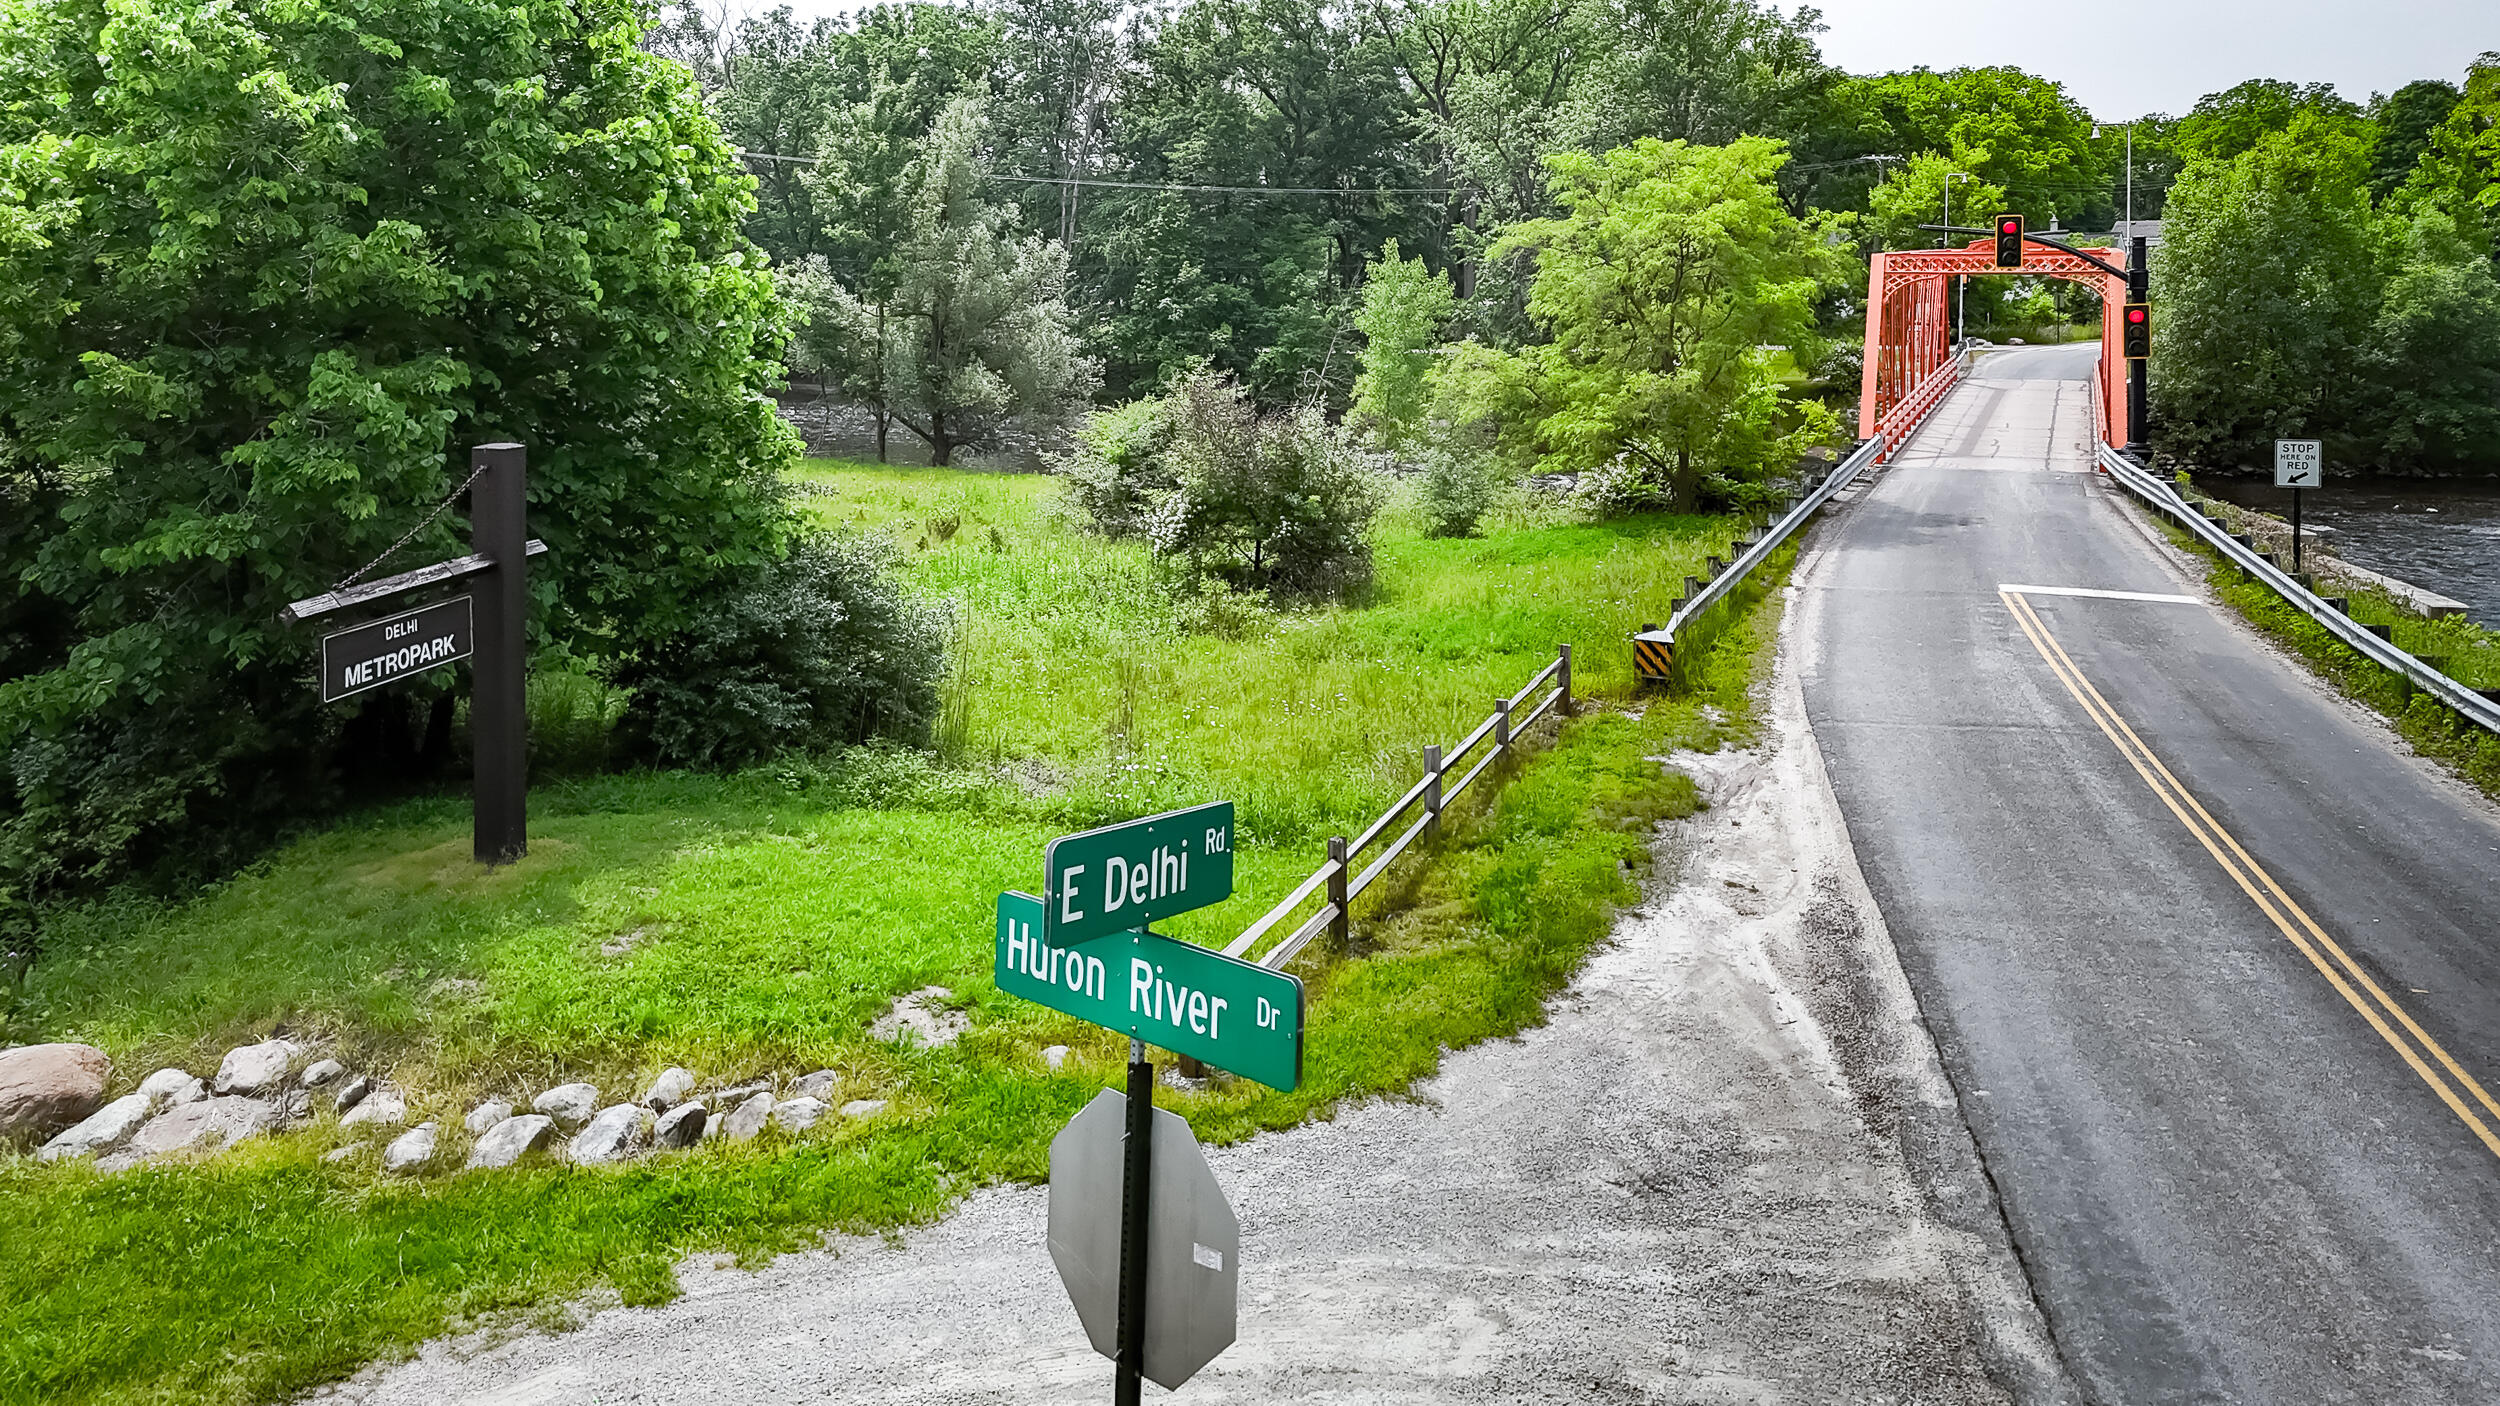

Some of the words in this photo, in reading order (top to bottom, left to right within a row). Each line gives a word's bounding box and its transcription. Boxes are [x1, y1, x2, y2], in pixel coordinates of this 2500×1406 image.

[2282, 443, 2314, 453] STOP
[2287, 462, 2309, 470] RED
[385, 618, 418, 641] DELHI
[344, 634, 456, 689] METROPARK
[1061, 864, 1085, 924] E
[1104, 839, 1188, 913] Delhi
[1205, 826, 1231, 855] Rd.
[1007, 918, 1105, 1001] Huron
[1129, 957, 1228, 1040] River
[1256, 996, 1281, 1031] Dr
